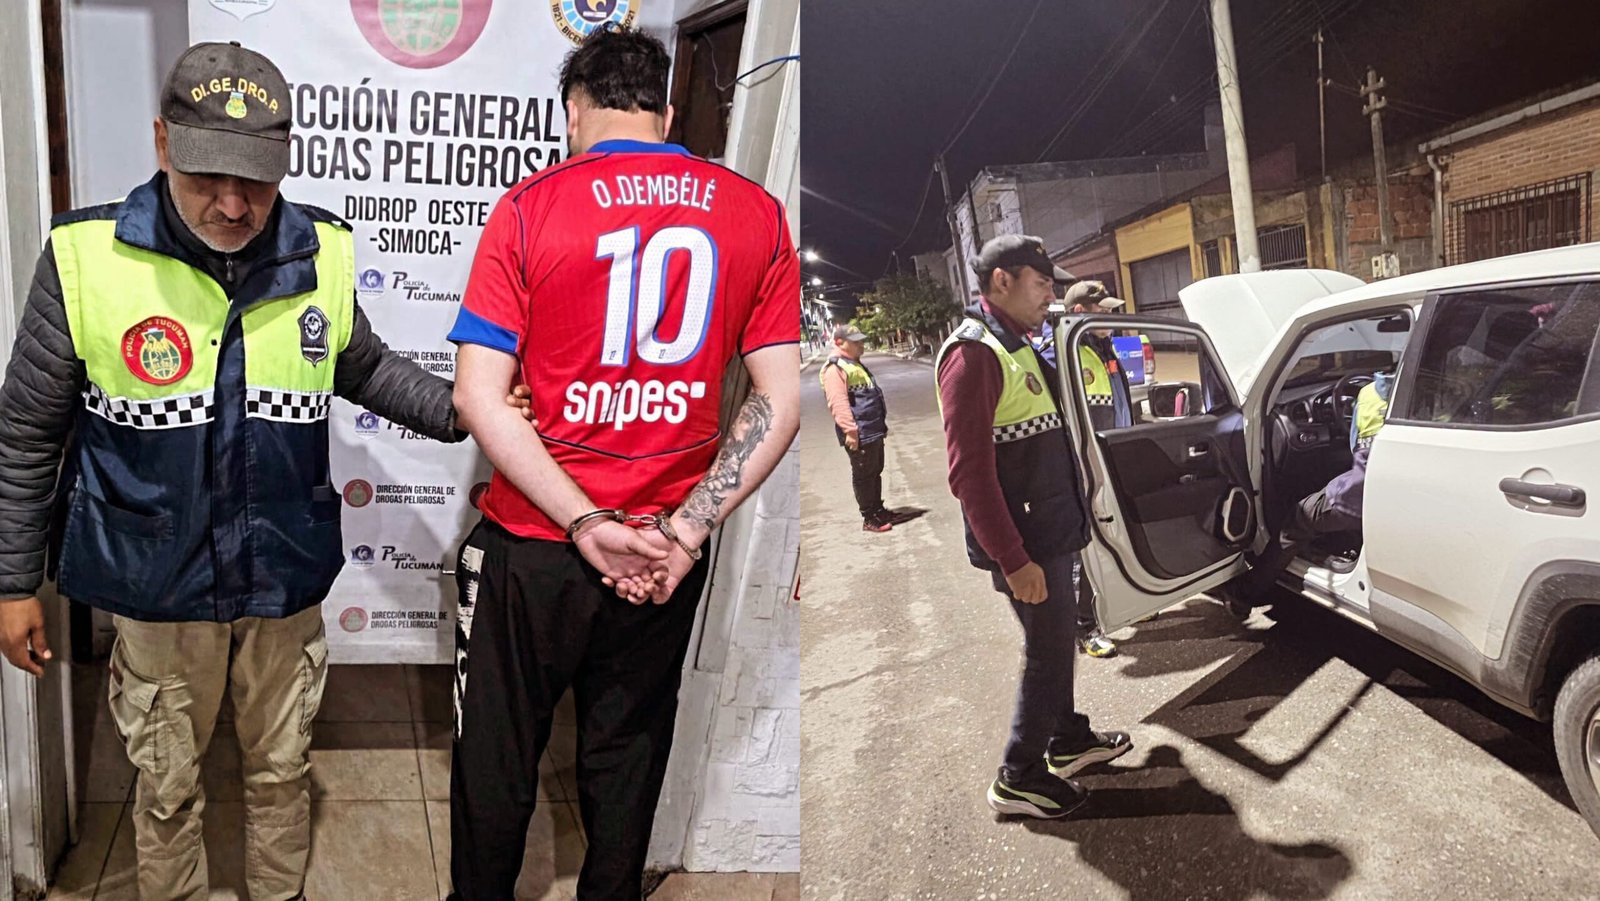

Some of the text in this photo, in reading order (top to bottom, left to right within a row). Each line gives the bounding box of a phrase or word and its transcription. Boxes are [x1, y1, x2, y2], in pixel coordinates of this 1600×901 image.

[287, 77, 561, 143] CCIÓN GENERAL
[592, 172, 716, 212] O.DEMBÉLÉ
[345, 195, 489, 227] DIDROP OESTE
[369, 227, 462, 256] -SIMOCA-
[594, 224, 719, 367] 10
[421, 351, 453, 362] GENERAL
[563, 379, 689, 431] snipes
[375, 494, 446, 505] DROGAS PELIGROSAS
[376, 483, 456, 496] DIRECCIÓN GENERAL DE
[371, 609, 448, 621] DIRECCIÓN GENERAL DE
[371, 620, 438, 629] DROGAS PELIGROSAS
